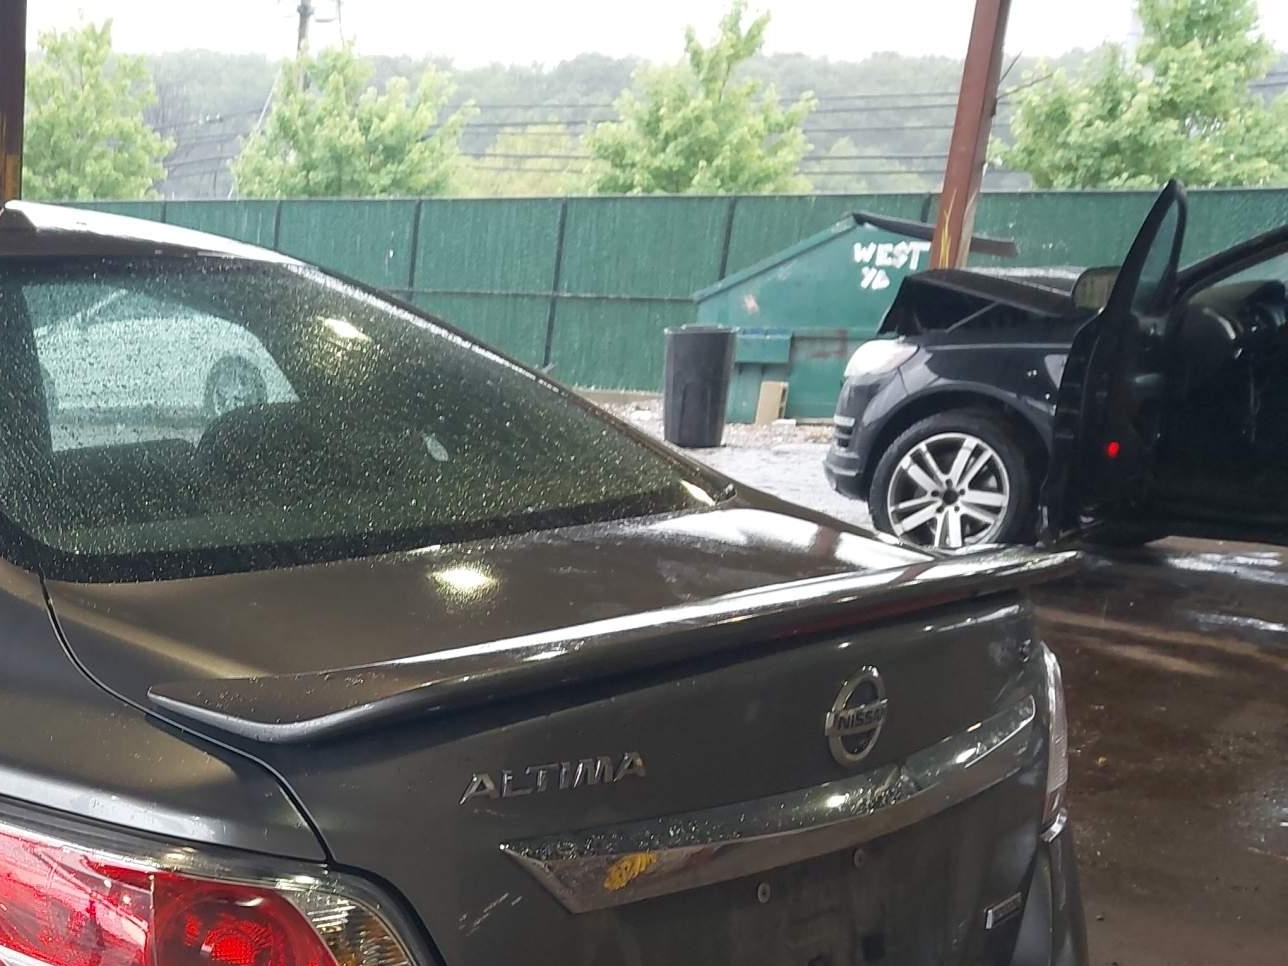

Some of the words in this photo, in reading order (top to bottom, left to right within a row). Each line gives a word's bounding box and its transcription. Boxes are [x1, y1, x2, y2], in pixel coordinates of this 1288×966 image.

[853, 241, 932, 270] WEST
[833, 701, 887, 731] NISSAN
[459, 752, 647, 805] ALTIMA
